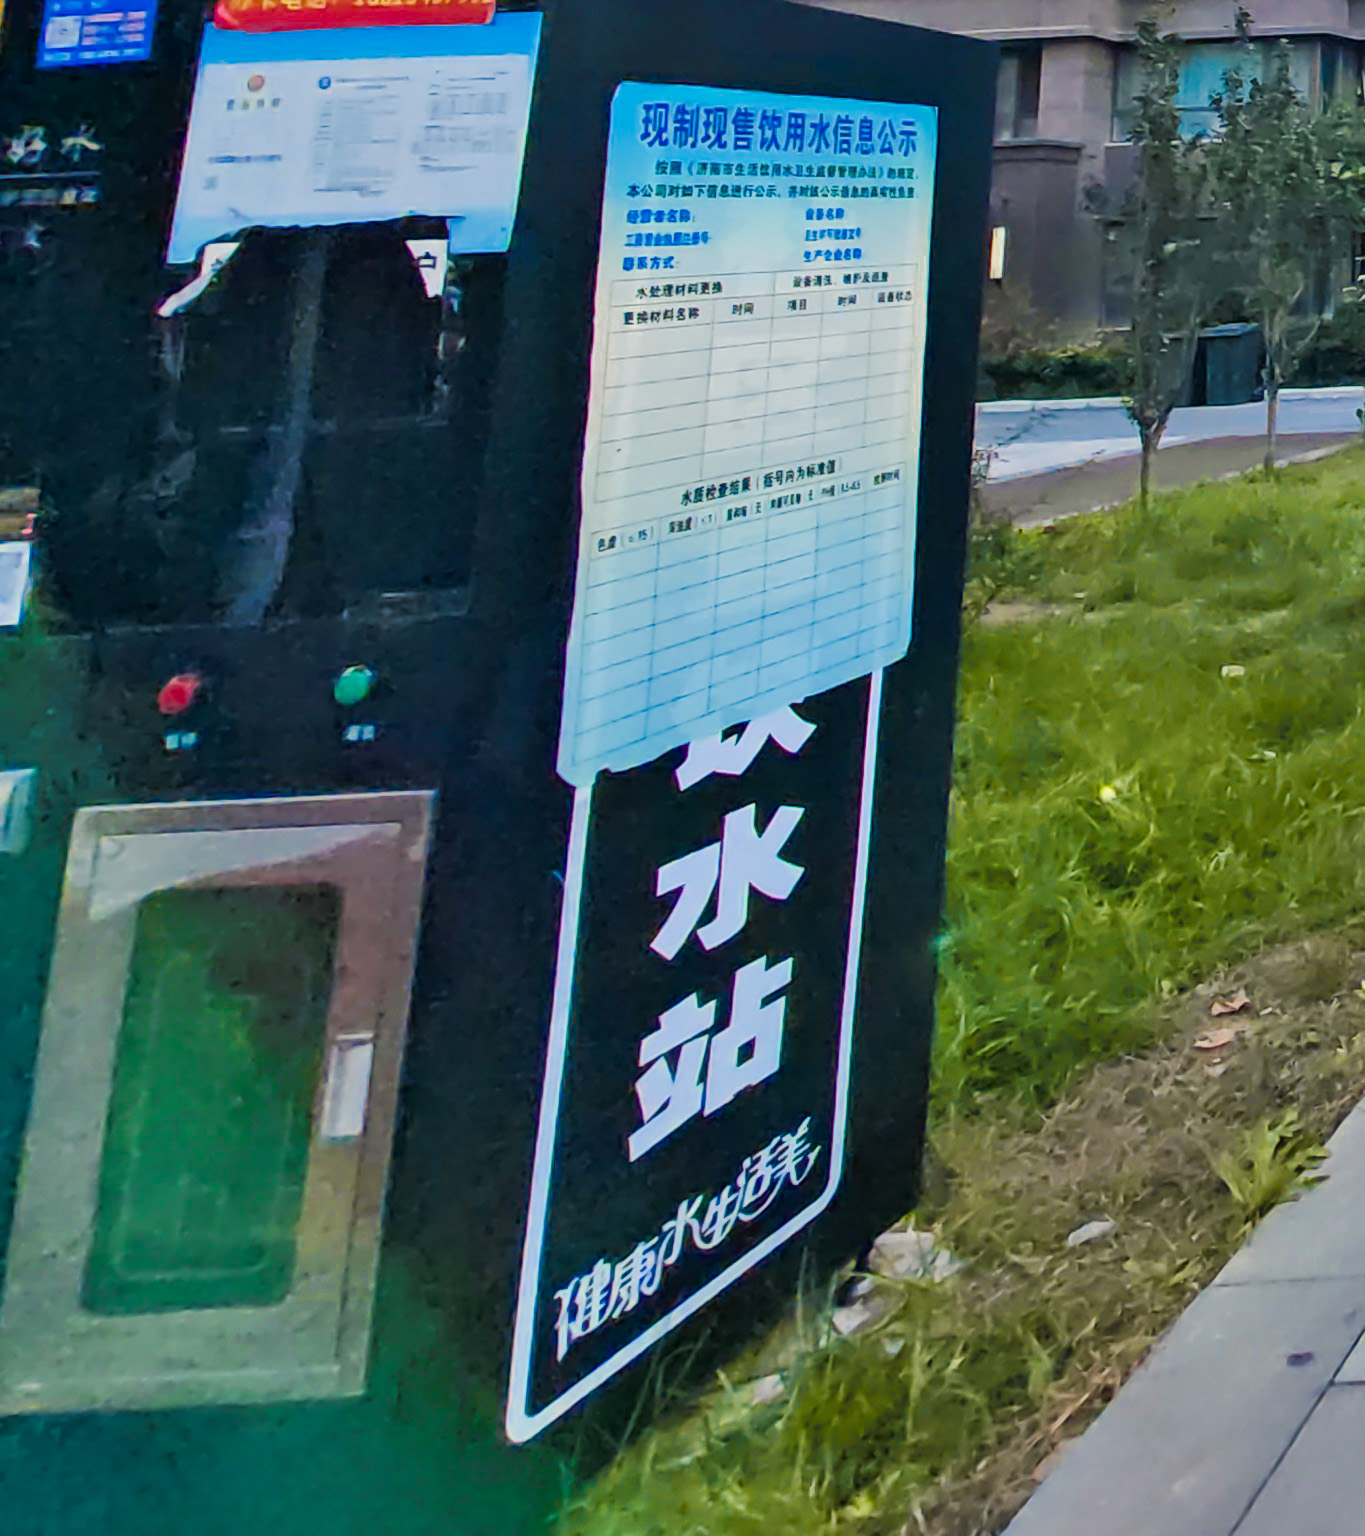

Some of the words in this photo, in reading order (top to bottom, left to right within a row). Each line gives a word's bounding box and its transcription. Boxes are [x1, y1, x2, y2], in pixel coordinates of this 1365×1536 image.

[640, 102, 918, 157] 现制现售饮用水信息公示
